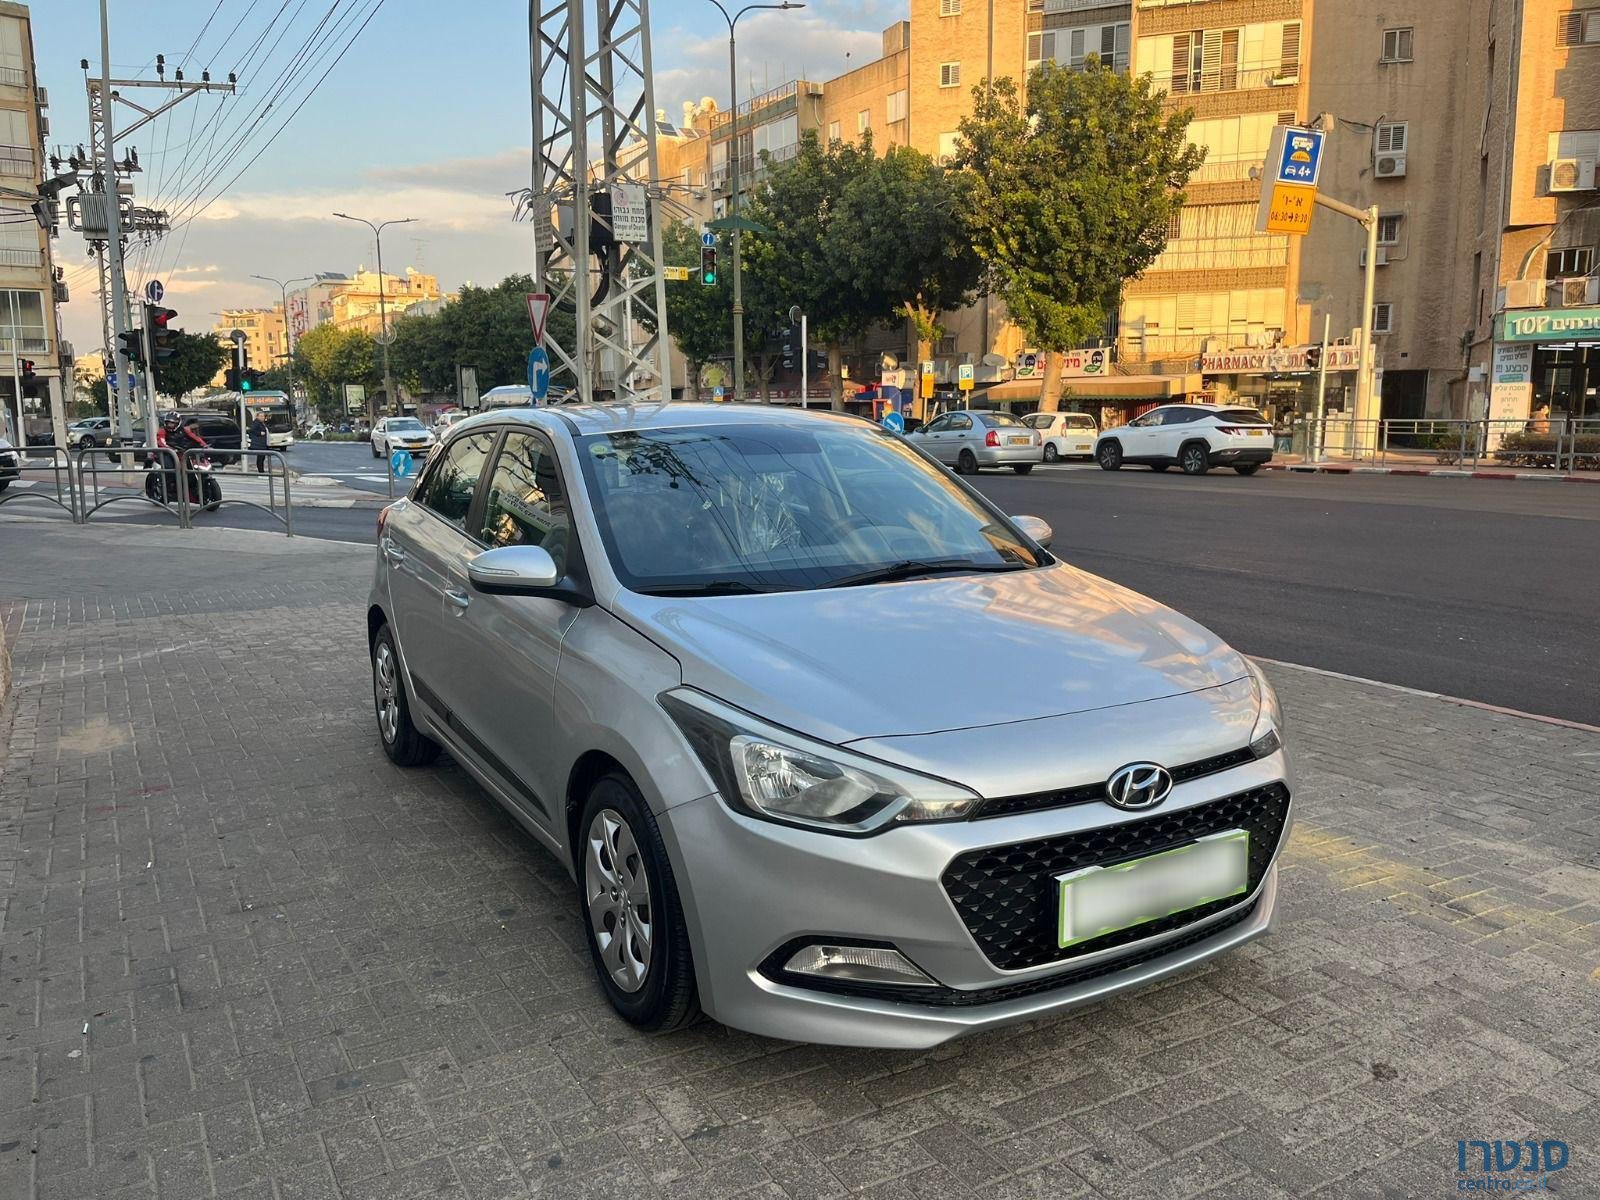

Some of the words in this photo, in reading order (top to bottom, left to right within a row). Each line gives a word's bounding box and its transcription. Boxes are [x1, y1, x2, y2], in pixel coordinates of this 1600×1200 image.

[1298, 165, 1311, 177] 4+
[614, 222, 628, 231] Danger
[1512, 315, 1550, 336] TOP
[1201, 354, 1266, 371] PHARMACY
